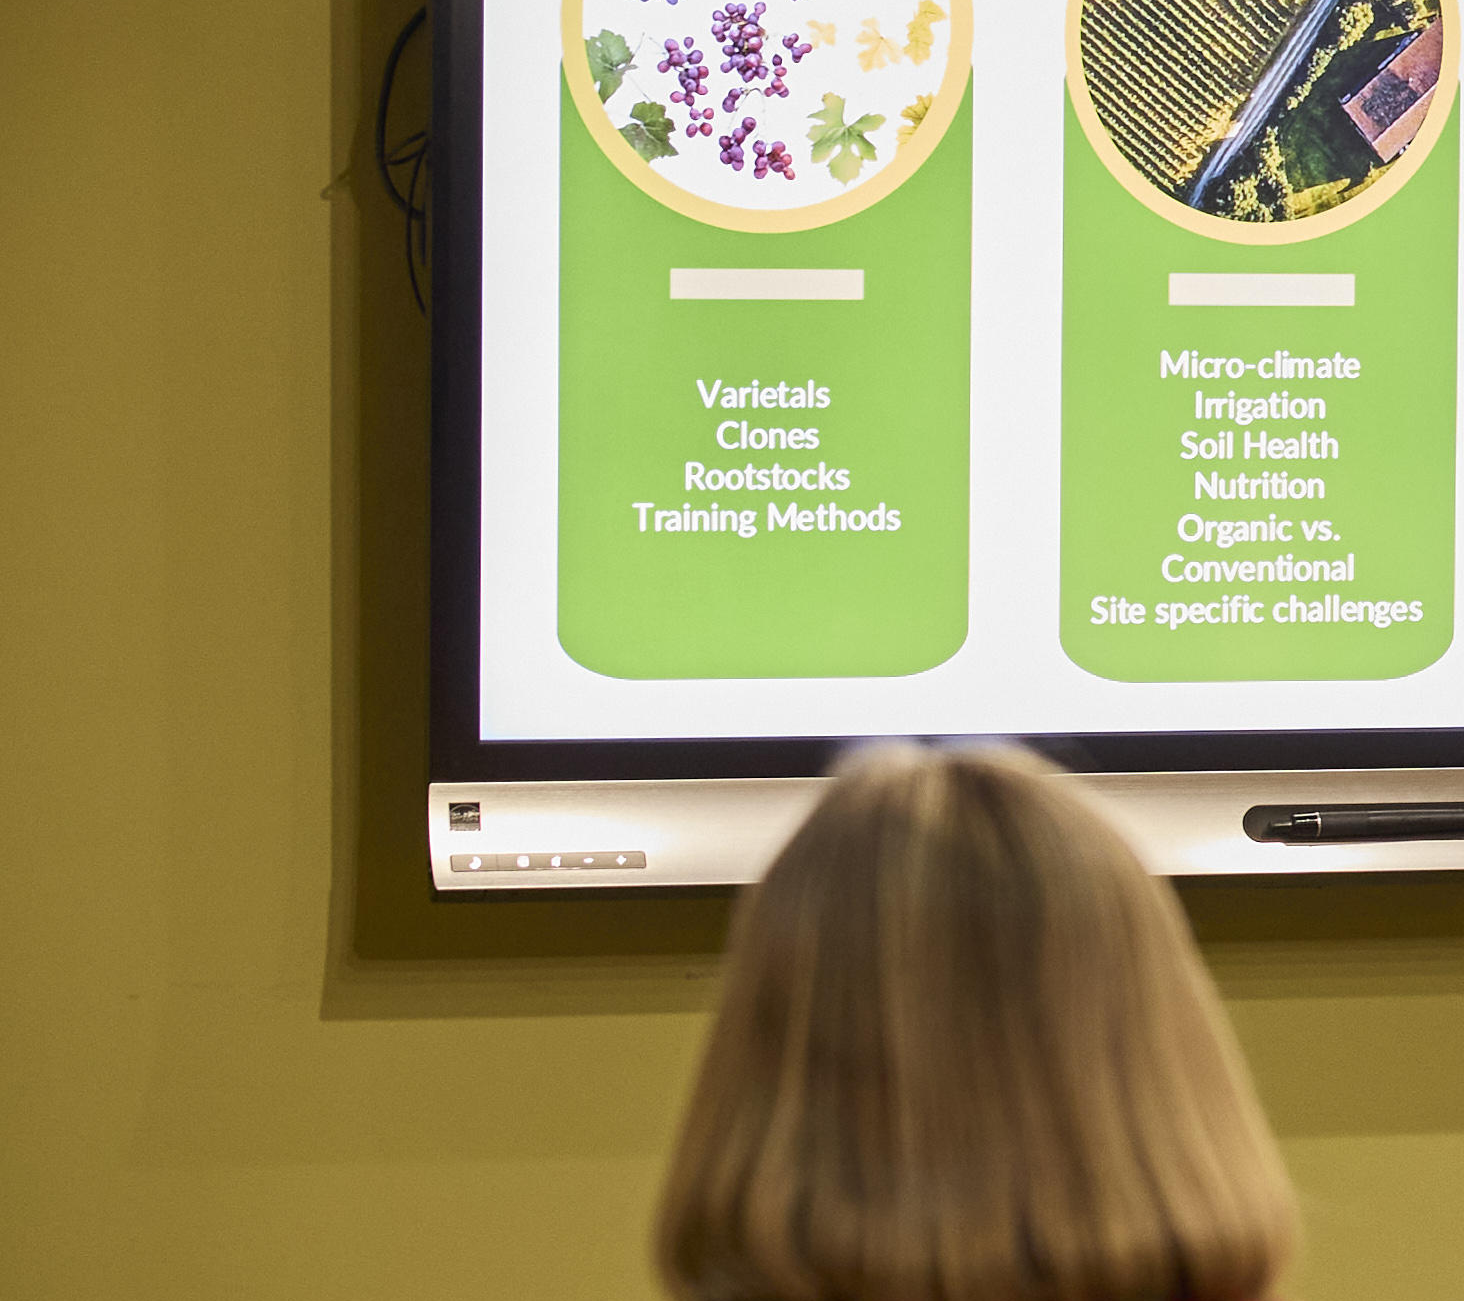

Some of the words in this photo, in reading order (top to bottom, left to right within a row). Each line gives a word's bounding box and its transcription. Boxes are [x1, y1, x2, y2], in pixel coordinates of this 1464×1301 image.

[1159, 349, 1362, 380] Micro-climate
[695, 378, 832, 409] Varietals
[1194, 389, 1327, 426] Irrigation
[715, 419, 821, 451] Clones
[1179, 430, 1235, 460] Soil
[1243, 430, 1340, 460] Health
[684, 460, 852, 491] Rootstocks
[1194, 470, 1326, 500] Nutrition
[631, 501, 758, 539] Training
[767, 501, 902, 532] Methods
[1176, 512, 1294, 549] Organic
[1299, 519, 1342, 542] vs.
[1161, 551, 1355, 583] Conventional
[1089, 595, 1147, 625] Site
[1153, 593, 1265, 631] specific
[1271, 593, 1424, 629] challenges
